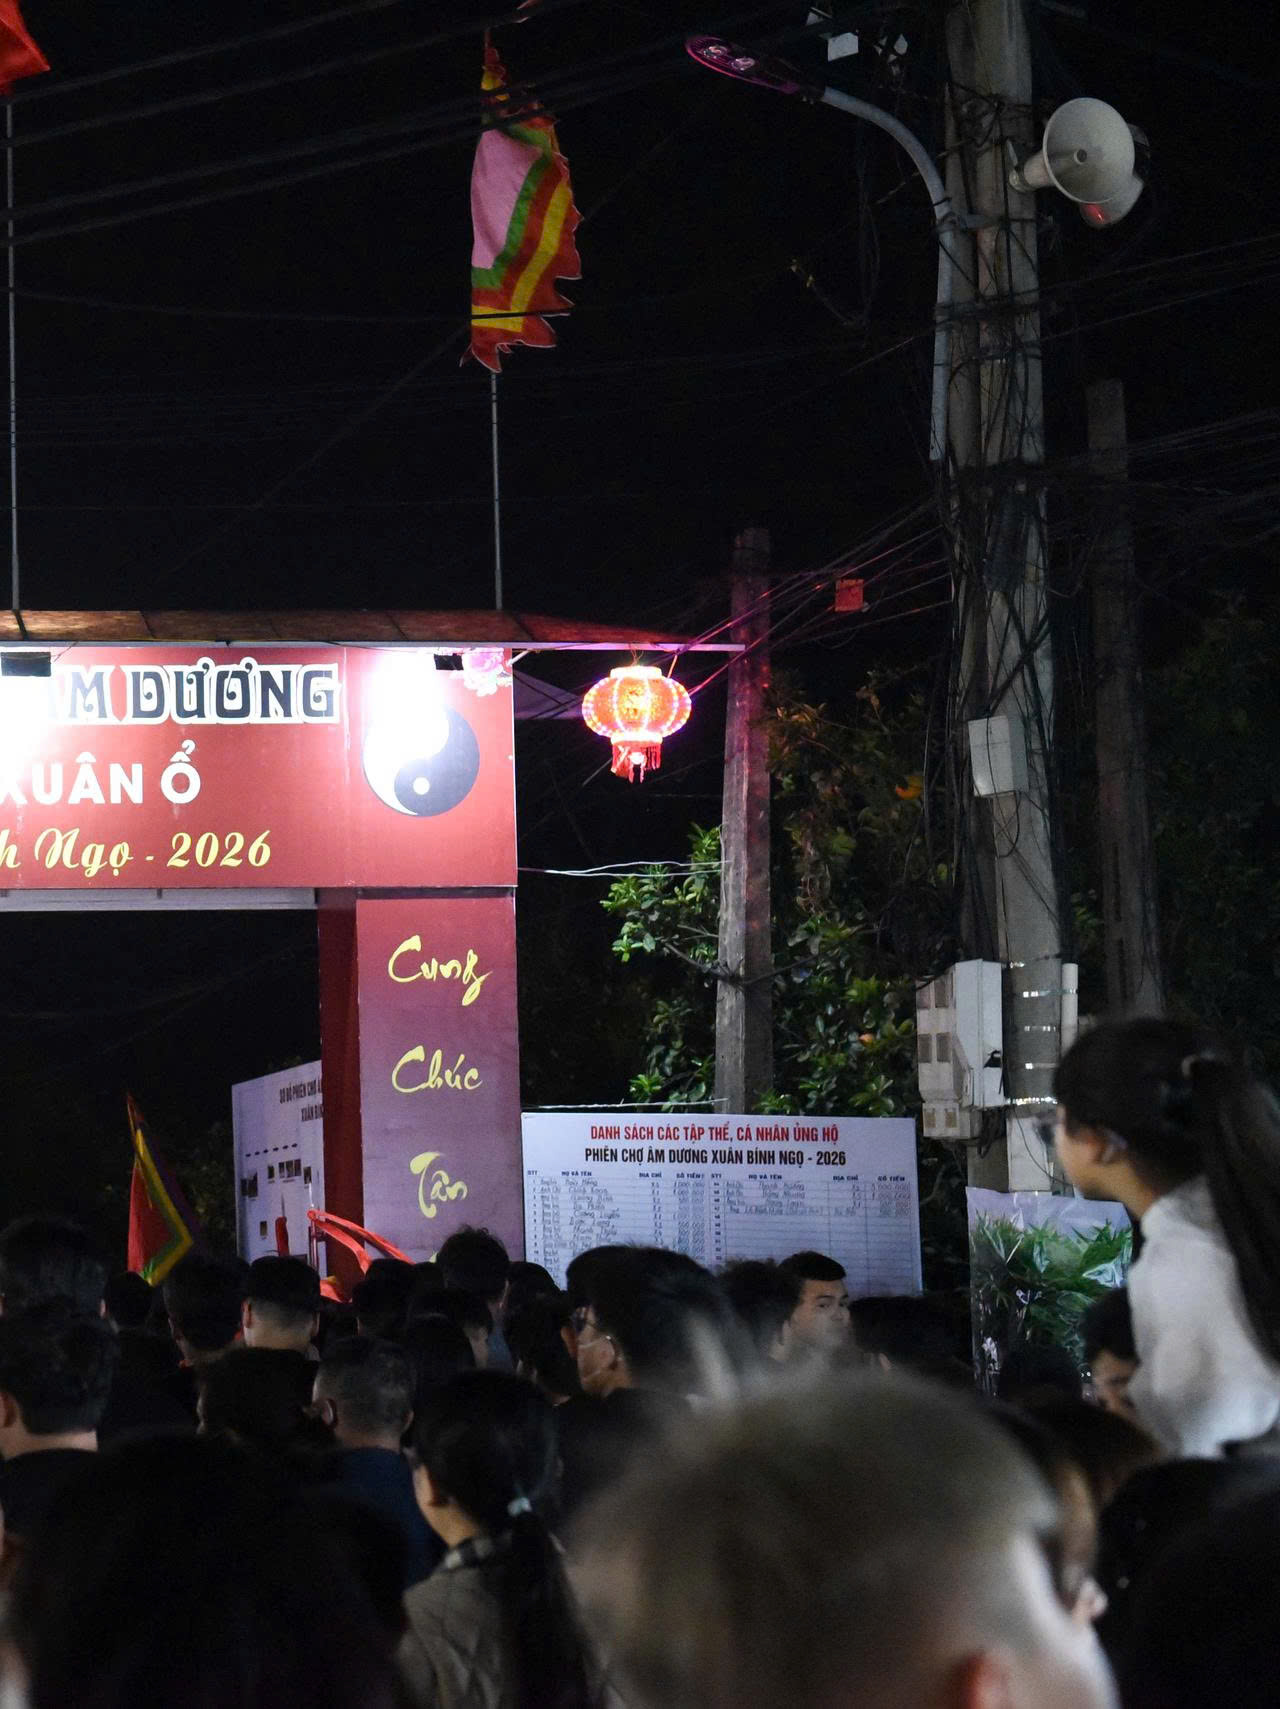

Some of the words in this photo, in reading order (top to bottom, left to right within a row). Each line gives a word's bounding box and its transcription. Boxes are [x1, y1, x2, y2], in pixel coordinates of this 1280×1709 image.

[125, 656, 342, 724] DƯƠNG
[161, 739, 201, 804] Ổ
[34, 827, 134, 877] Ngọ
[167, 830, 272, 868] 2026
[388, 934, 492, 1006] Cung
[392, 1046, 482, 1093] Chúc
[585, 1146, 618, 1162] PHIÊN
[622, 1148, 645, 1165] CHỢ
[647, 1146, 665, 1163] ÂM
[669, 1148, 708, 1164] DƯƠNG
[711, 1147, 743, 1164] XUÂN
[746, 1148, 775, 1164] BÍNH
[779, 1150, 804, 1168] NGỌ
[817, 1152, 847, 1166] 2026
[591, 1126, 620, 1141] DANH
[624, 1123, 654, 1141] SÁCH
[657, 1122, 680, 1141] CÁC
[683, 1124, 705, 1144] TẬP
[737, 1123, 752, 1141] CÁ
[756, 1123, 789, 1142] NHÂN
[793, 1123, 820, 1142] ỦNG
[822, 1124, 839, 1145] HỘ
[409, 1151, 467, 1218] Tân
